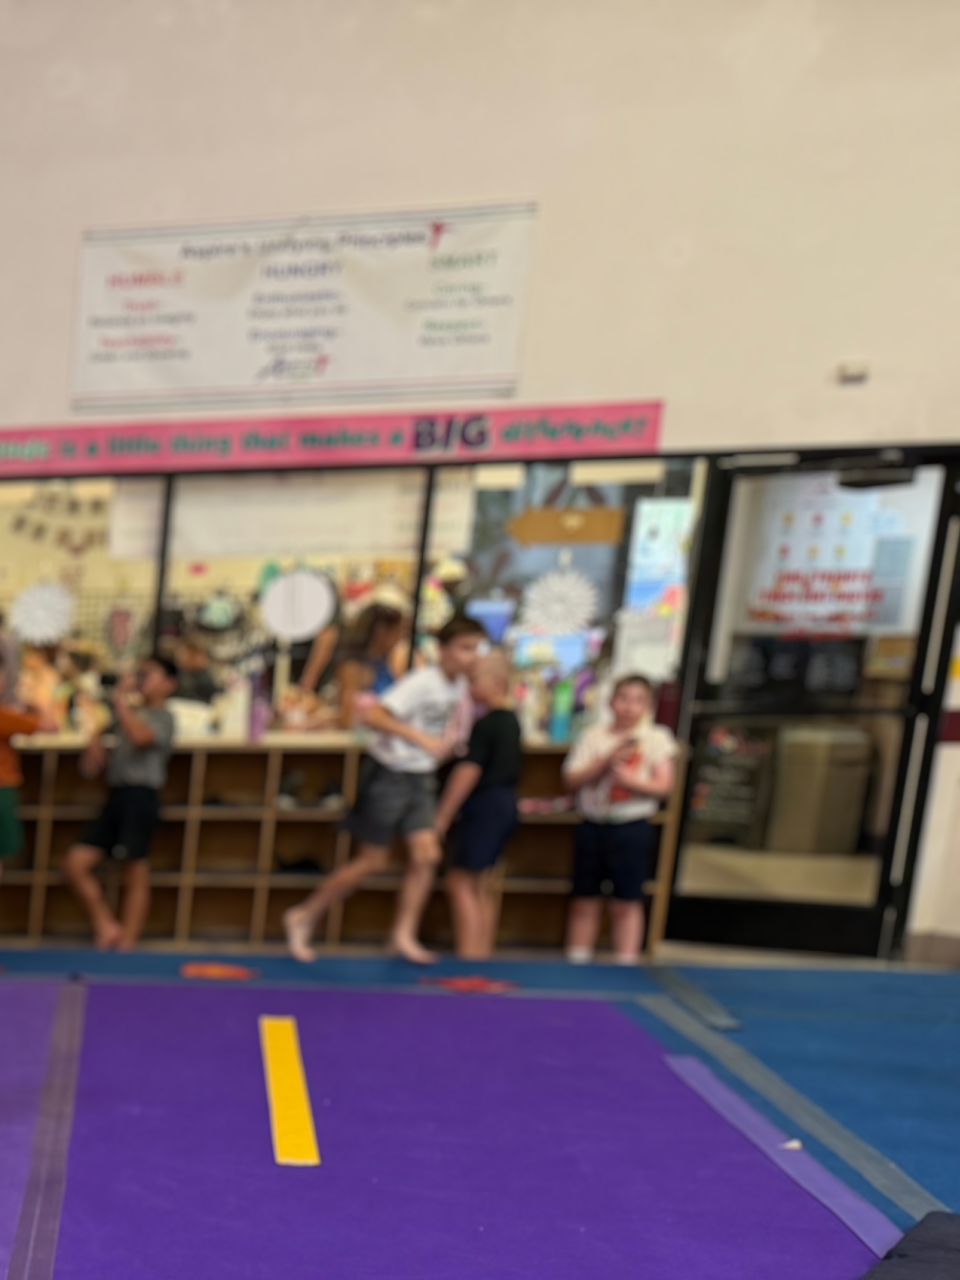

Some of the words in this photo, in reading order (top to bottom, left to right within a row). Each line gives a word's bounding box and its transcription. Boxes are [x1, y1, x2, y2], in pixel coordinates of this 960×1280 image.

[107, 433, 161, 455] little
[171, 431, 232, 459] thing
[244, 425, 289, 450] that
[300, 429, 380, 448] makes
[413, 414, 489, 450] BIG
